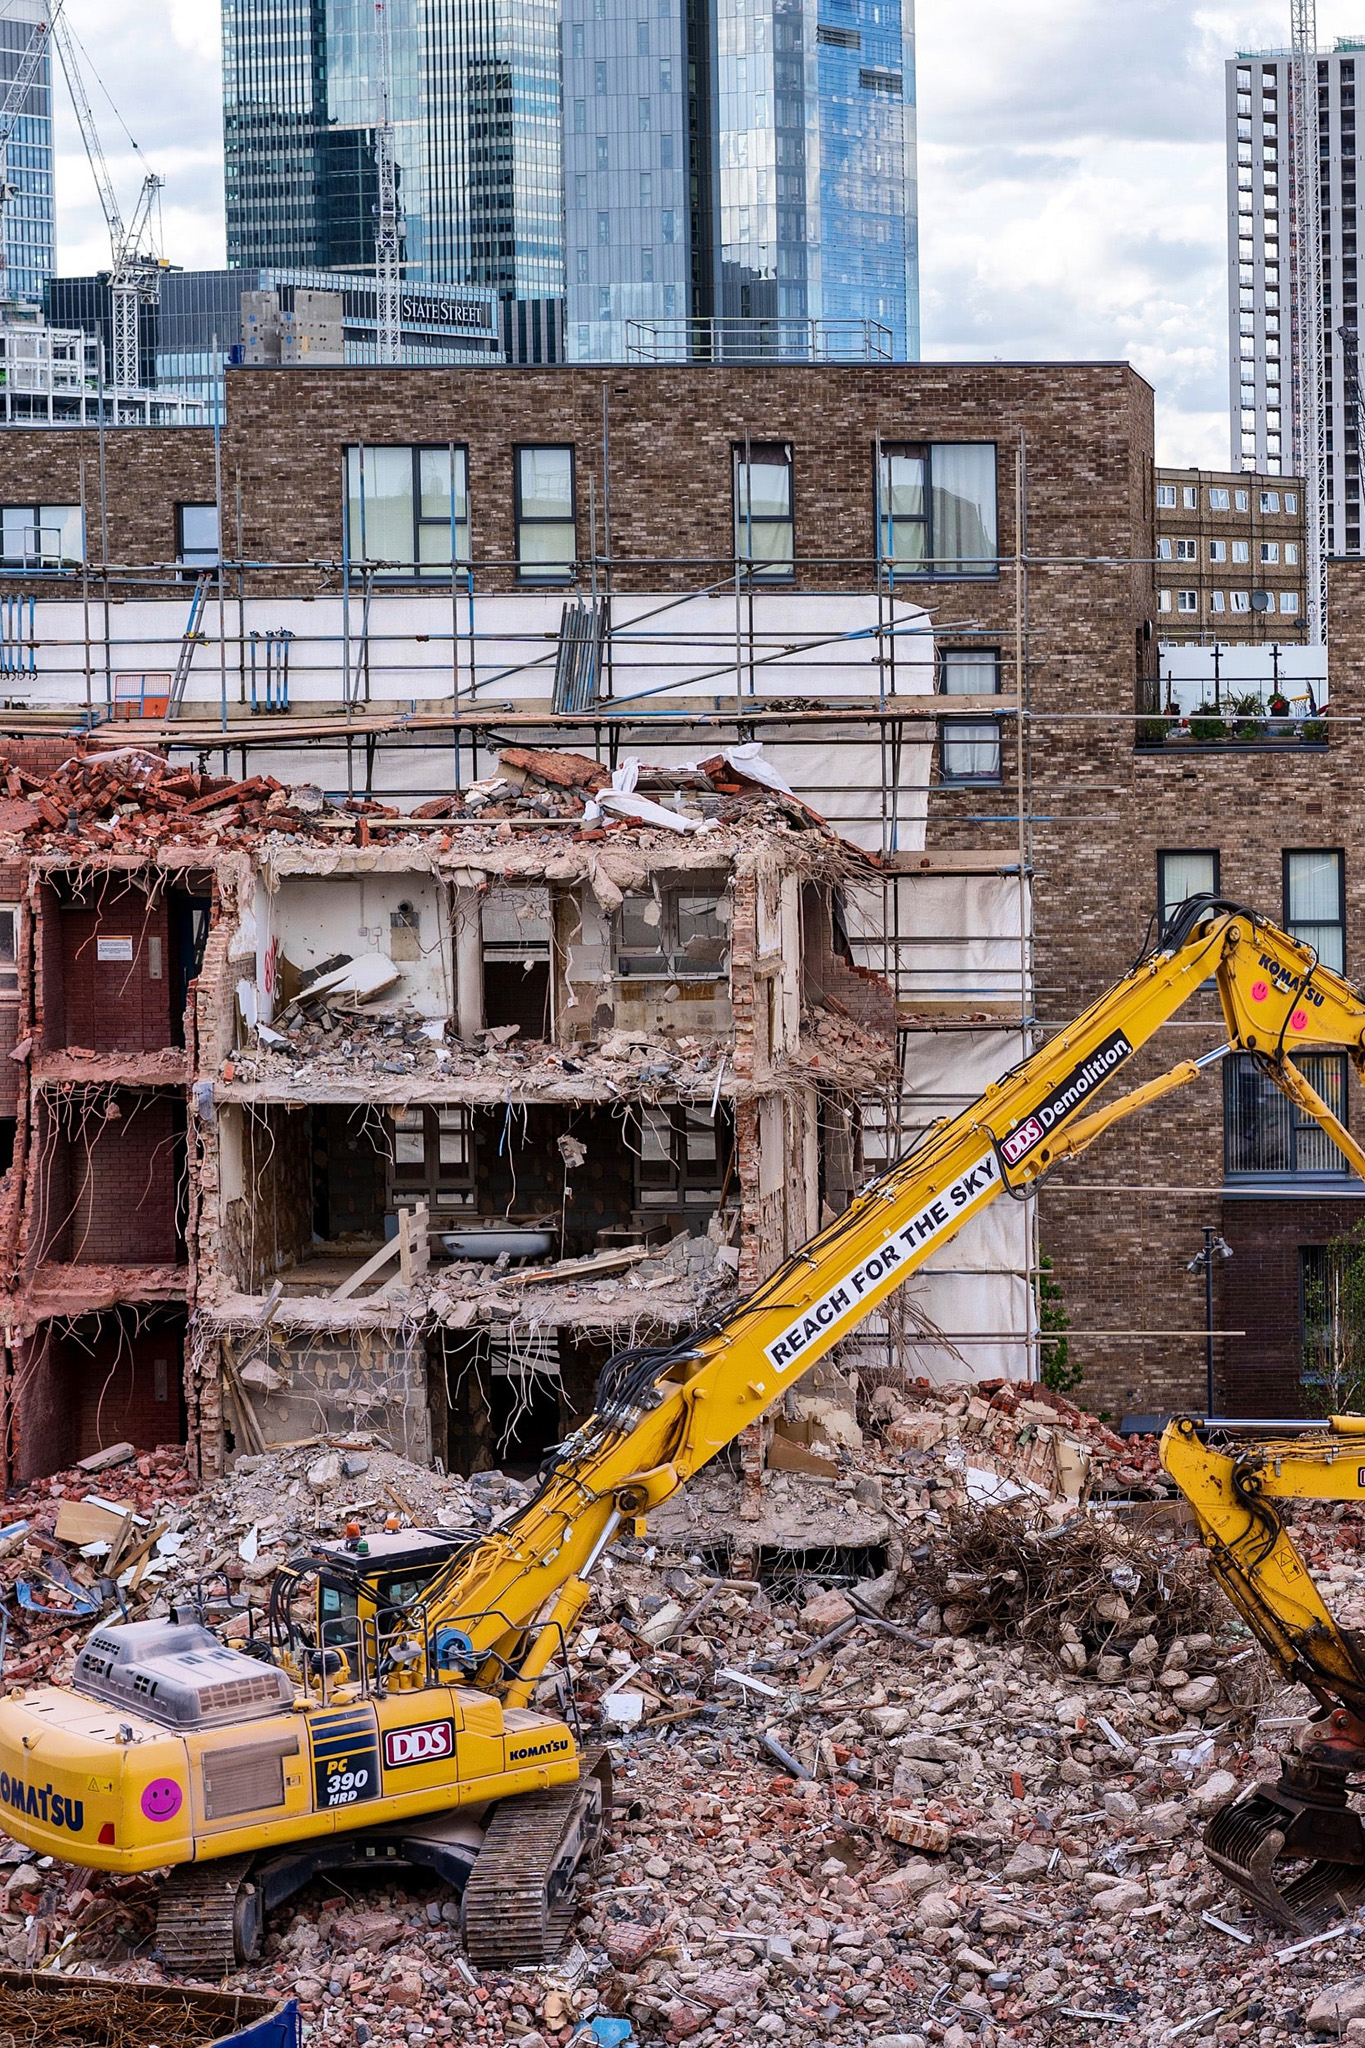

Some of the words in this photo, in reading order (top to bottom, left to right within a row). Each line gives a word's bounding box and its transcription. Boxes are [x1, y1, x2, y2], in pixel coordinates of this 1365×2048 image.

[403, 298, 439, 319] STATE
[440, 301, 481, 323] STREET
[1004, 1121, 1040, 1160] DDS
[1038, 1038, 1128, 1128] Demolition
[770, 1288, 851, 1366] REACH
[850, 1245, 902, 1294] FOR
[900, 1201, 949, 1249] THE
[949, 1156, 995, 1207] SKY
[393, 1726, 447, 1762] DDS
[510, 1740, 568, 1761] KOMATSU
[327, 1758, 347, 1775] PC
[327, 1769, 368, 1793] 390
[0, 1771, 83, 1832] OMATSU
[328, 1790, 357, 1806] HRD
